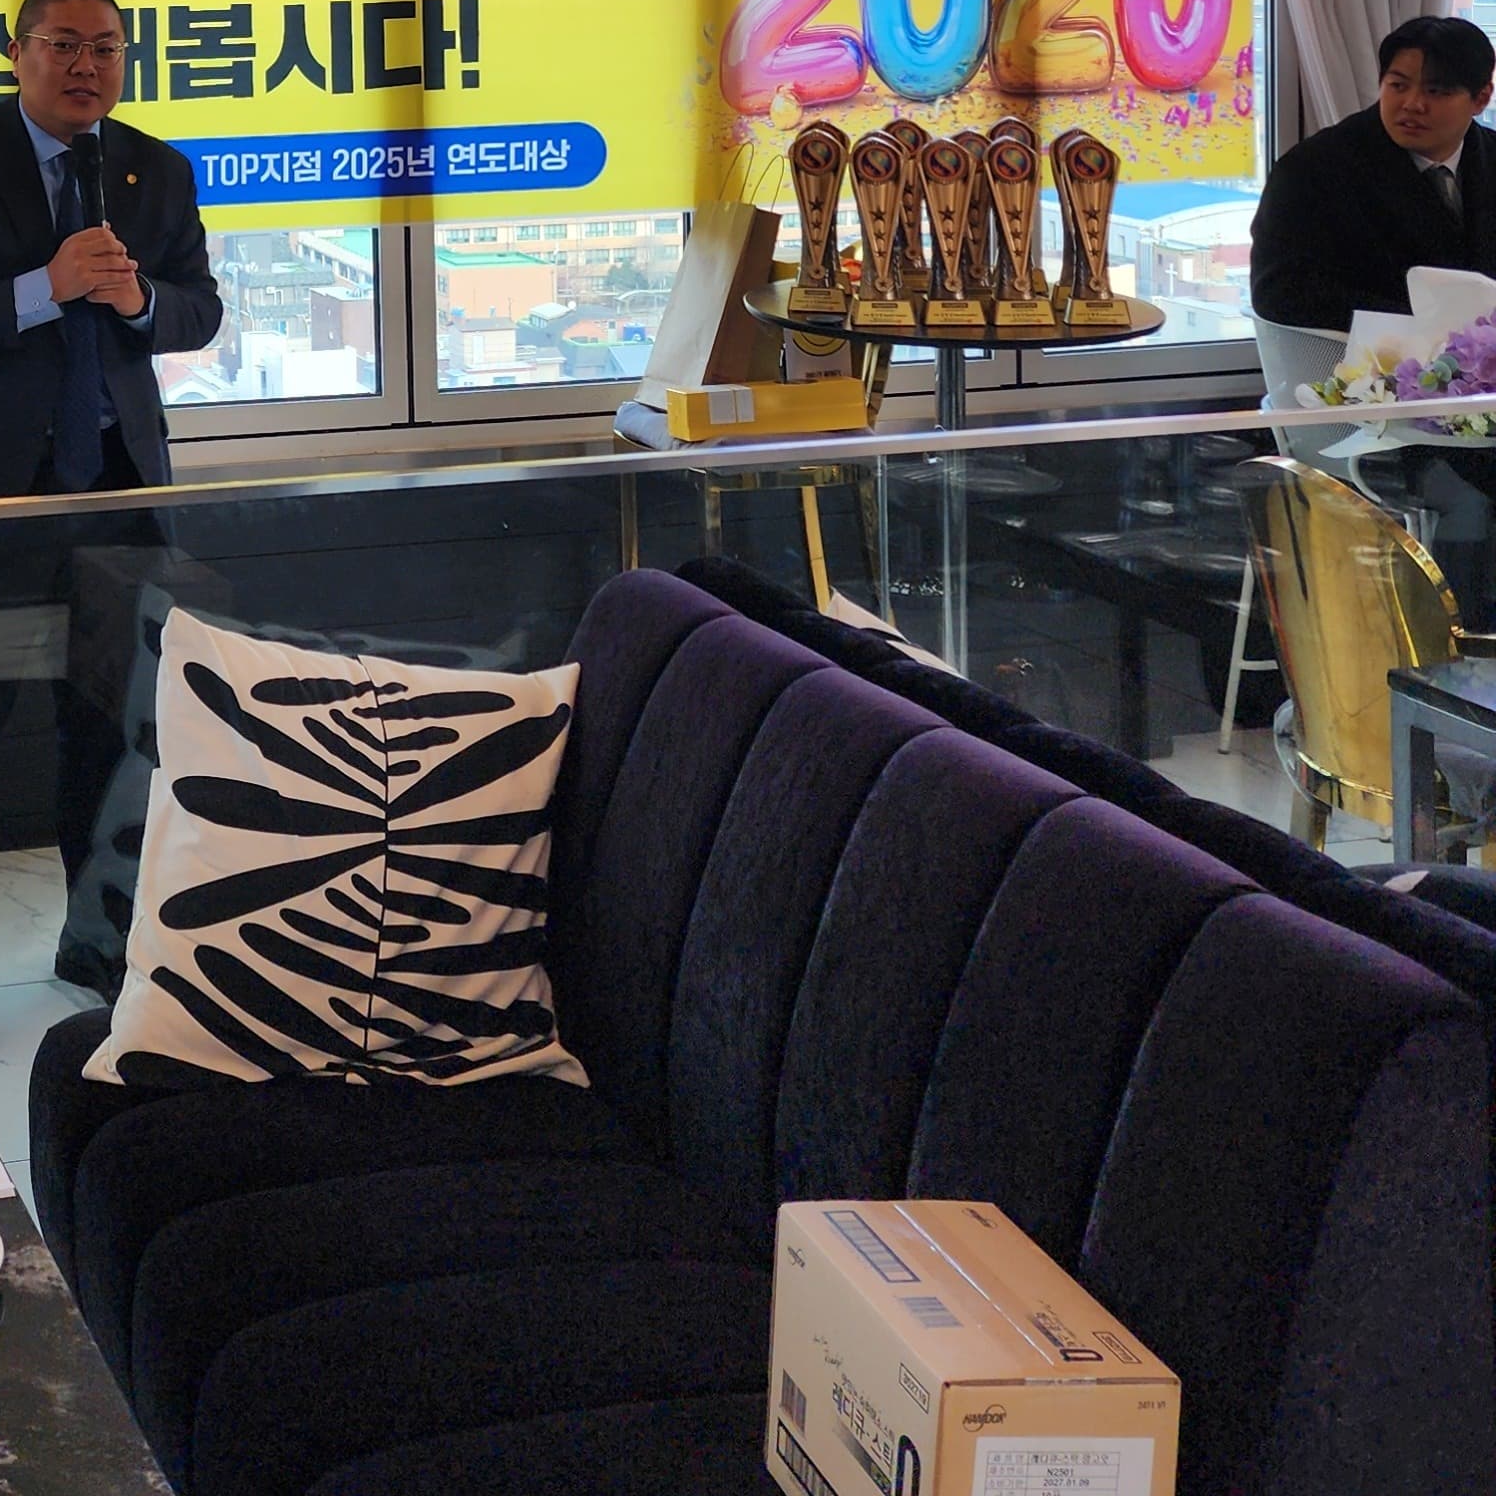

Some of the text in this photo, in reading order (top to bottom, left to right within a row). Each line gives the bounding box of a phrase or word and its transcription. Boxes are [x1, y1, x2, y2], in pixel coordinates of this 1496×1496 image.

[201, 138, 570, 186] TOP지점 2025년 연도대상
